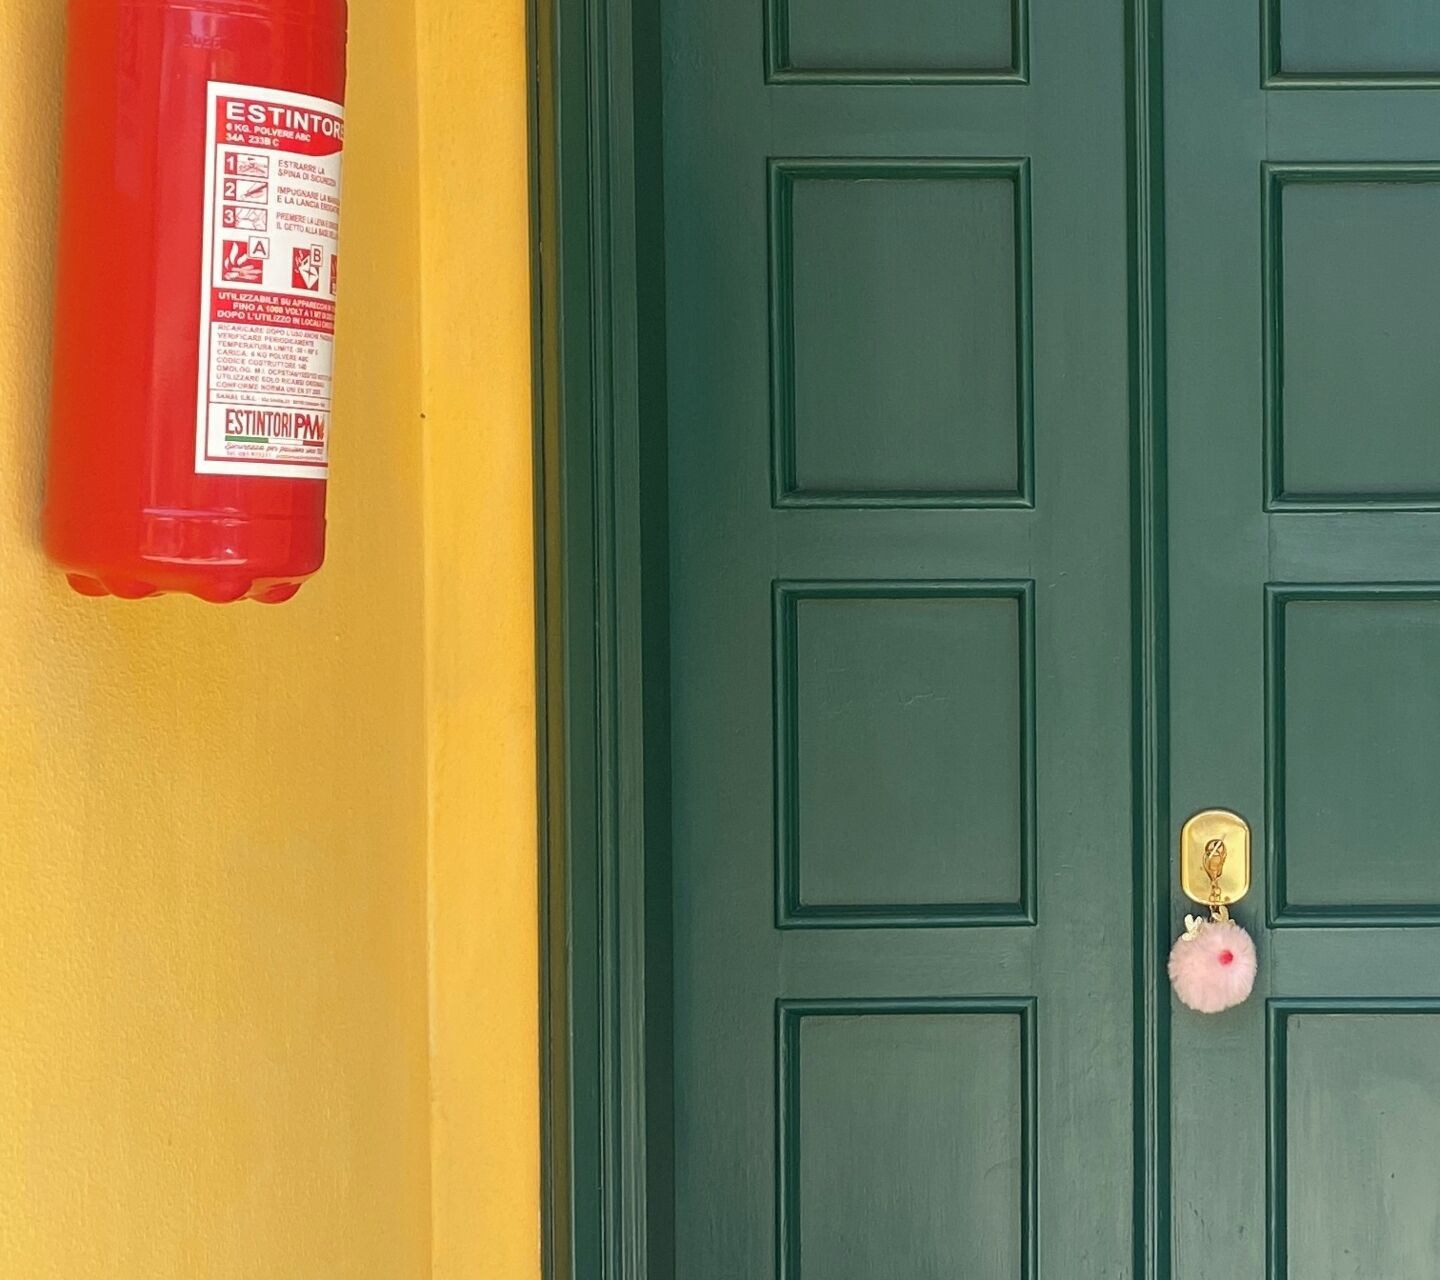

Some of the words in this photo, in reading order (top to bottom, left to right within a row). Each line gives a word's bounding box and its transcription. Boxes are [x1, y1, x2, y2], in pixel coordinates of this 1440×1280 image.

[225, 132, 245, 142] 34A
[254, 125, 294, 139] POLVERE
[294, 133, 311, 142] ABC
[227, 155, 234, 168] 1
[278, 168, 301, 179] SPINA
[302, 172, 309, 180] DI
[317, 167, 325, 175] LA
[225, 183, 235, 197] 2
[277, 186, 319, 200] IMPUGNARE
[277, 195, 282, 203] E
[284, 195, 294, 205] LA
[296, 198, 319, 209] LANCIA
[224, 209, 235, 224] 3
[276, 212, 305, 223] PREMERE
[253, 240, 266, 255] A
[313, 249, 321, 262] B
[218, 292, 279, 305] UTILIZZABILE
[281, 297, 291, 306] SU
[233, 301, 255, 311] FINO
[256, 303, 265, 312] A
[285, 306, 303, 316] VOLT
[217, 310, 245, 320] DOPO
[247, 312, 291, 323] L'UTILIZZO
[292, 316, 300, 324] IN
[217, 324, 264, 333] RICARICARE
[217, 332, 262, 342] VERIFICARE
[217, 340, 272, 351] TEMPERATURA
[216, 356, 246, 365] CODICE
[269, 353, 297, 361] POLVERE
[216, 374, 260, 382] UTILIZZARE
[216, 381, 259, 390] CONFORME
[261, 384, 285, 392] NORMA
[225, 408, 292, 438] ESTINTORI
